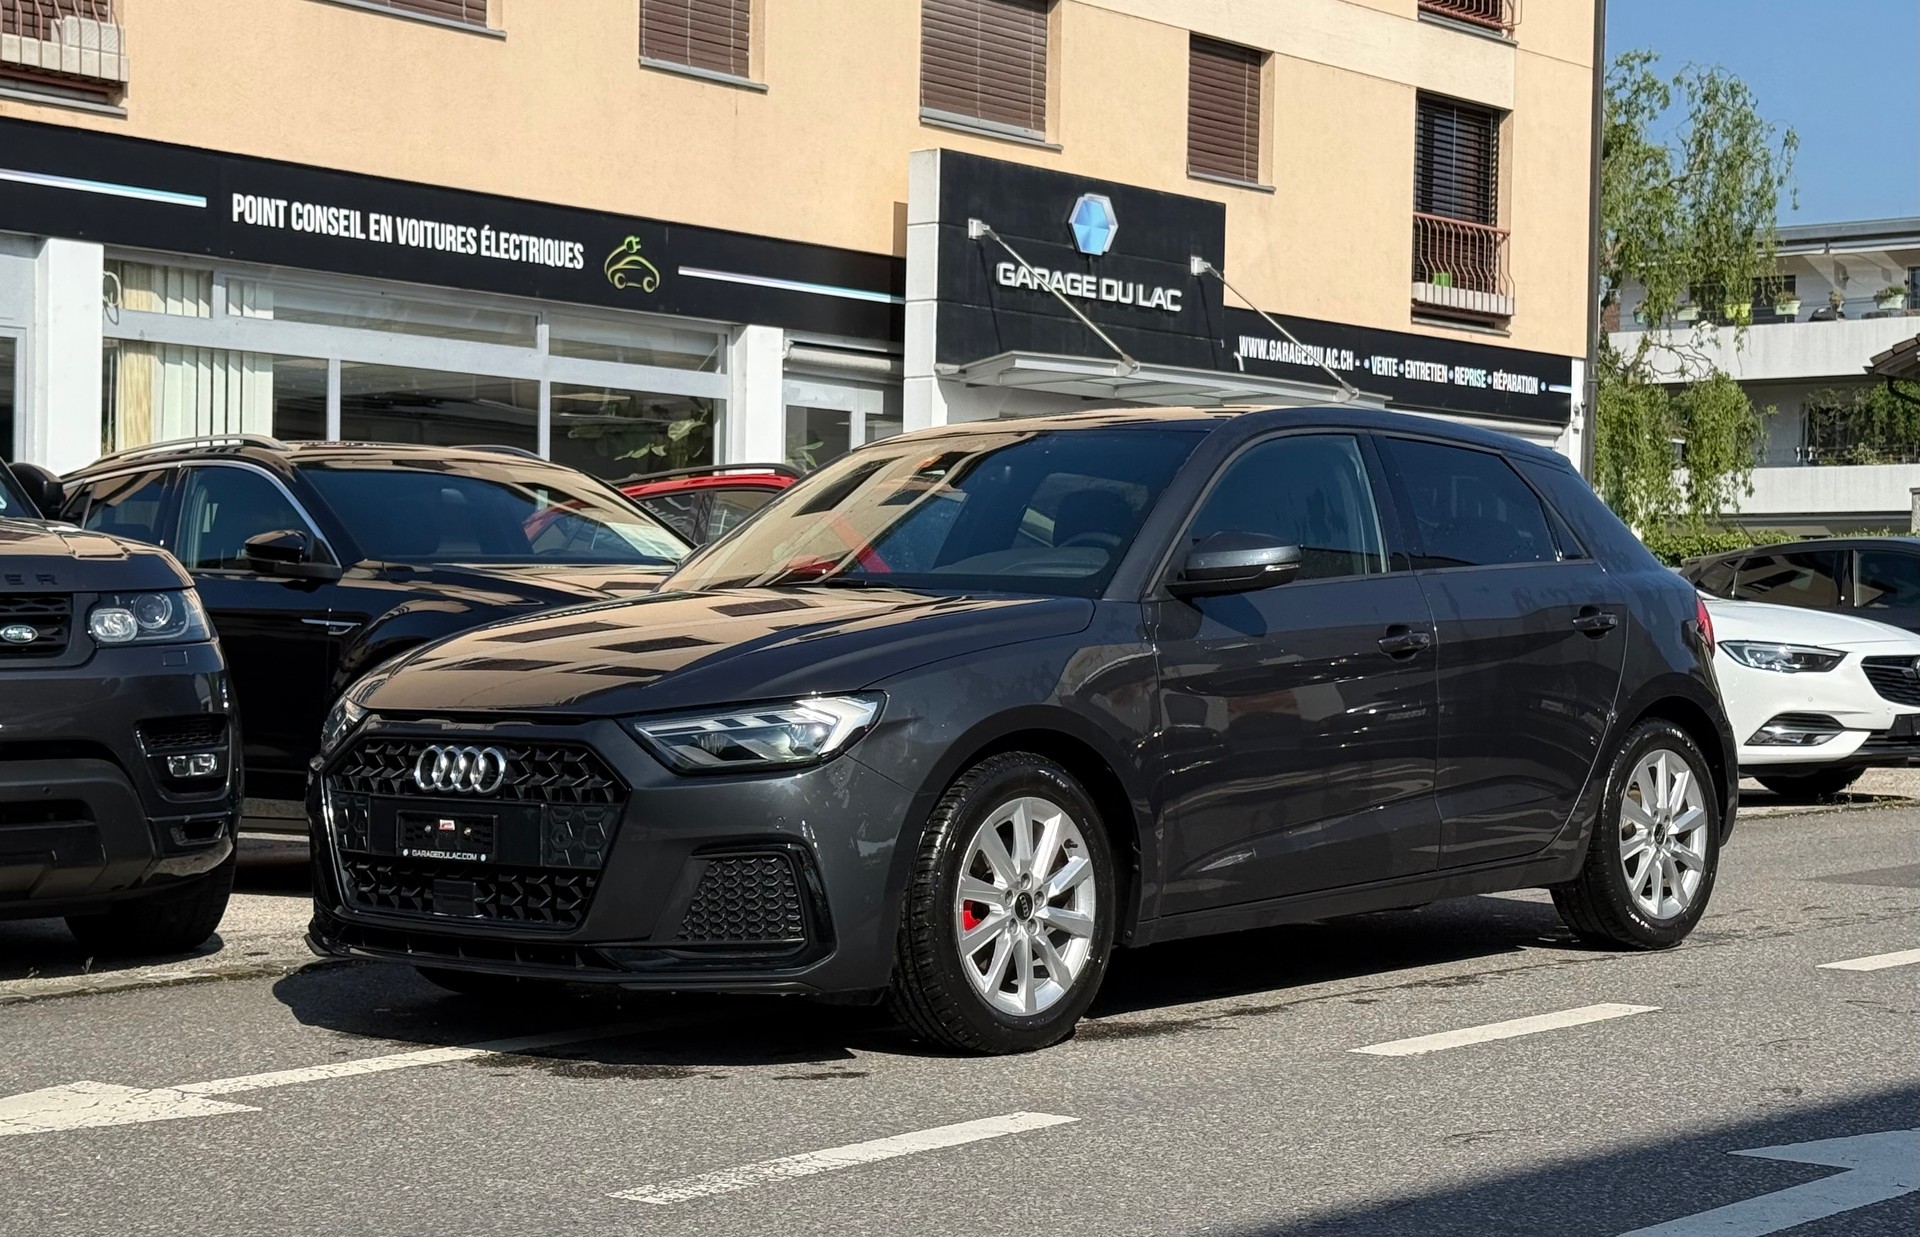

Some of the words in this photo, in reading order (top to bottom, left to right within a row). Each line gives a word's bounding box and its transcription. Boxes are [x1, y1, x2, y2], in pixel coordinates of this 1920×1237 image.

[232, 192, 287, 228] POINT
[290, 202, 366, 240] CONSEIL
[369, 214, 393, 244] EN
[396, 217, 478, 255] VOITURES
[480, 224, 584, 270] ÉLECTRIQUES
[996, 262, 1097, 299] GARAGE
[1100, 277, 1134, 304] DU
[1137, 283, 1182, 312] LAC
[1371, 355, 1398, 377] VENTE
[1405, 359, 1448, 384] ENTRETIEN
[1454, 366, 1487, 389] REPRISE
[1493, 369, 1538, 395] RÉPARATION
[412, 849, 477, 861] GARAGEDULAC.COM
